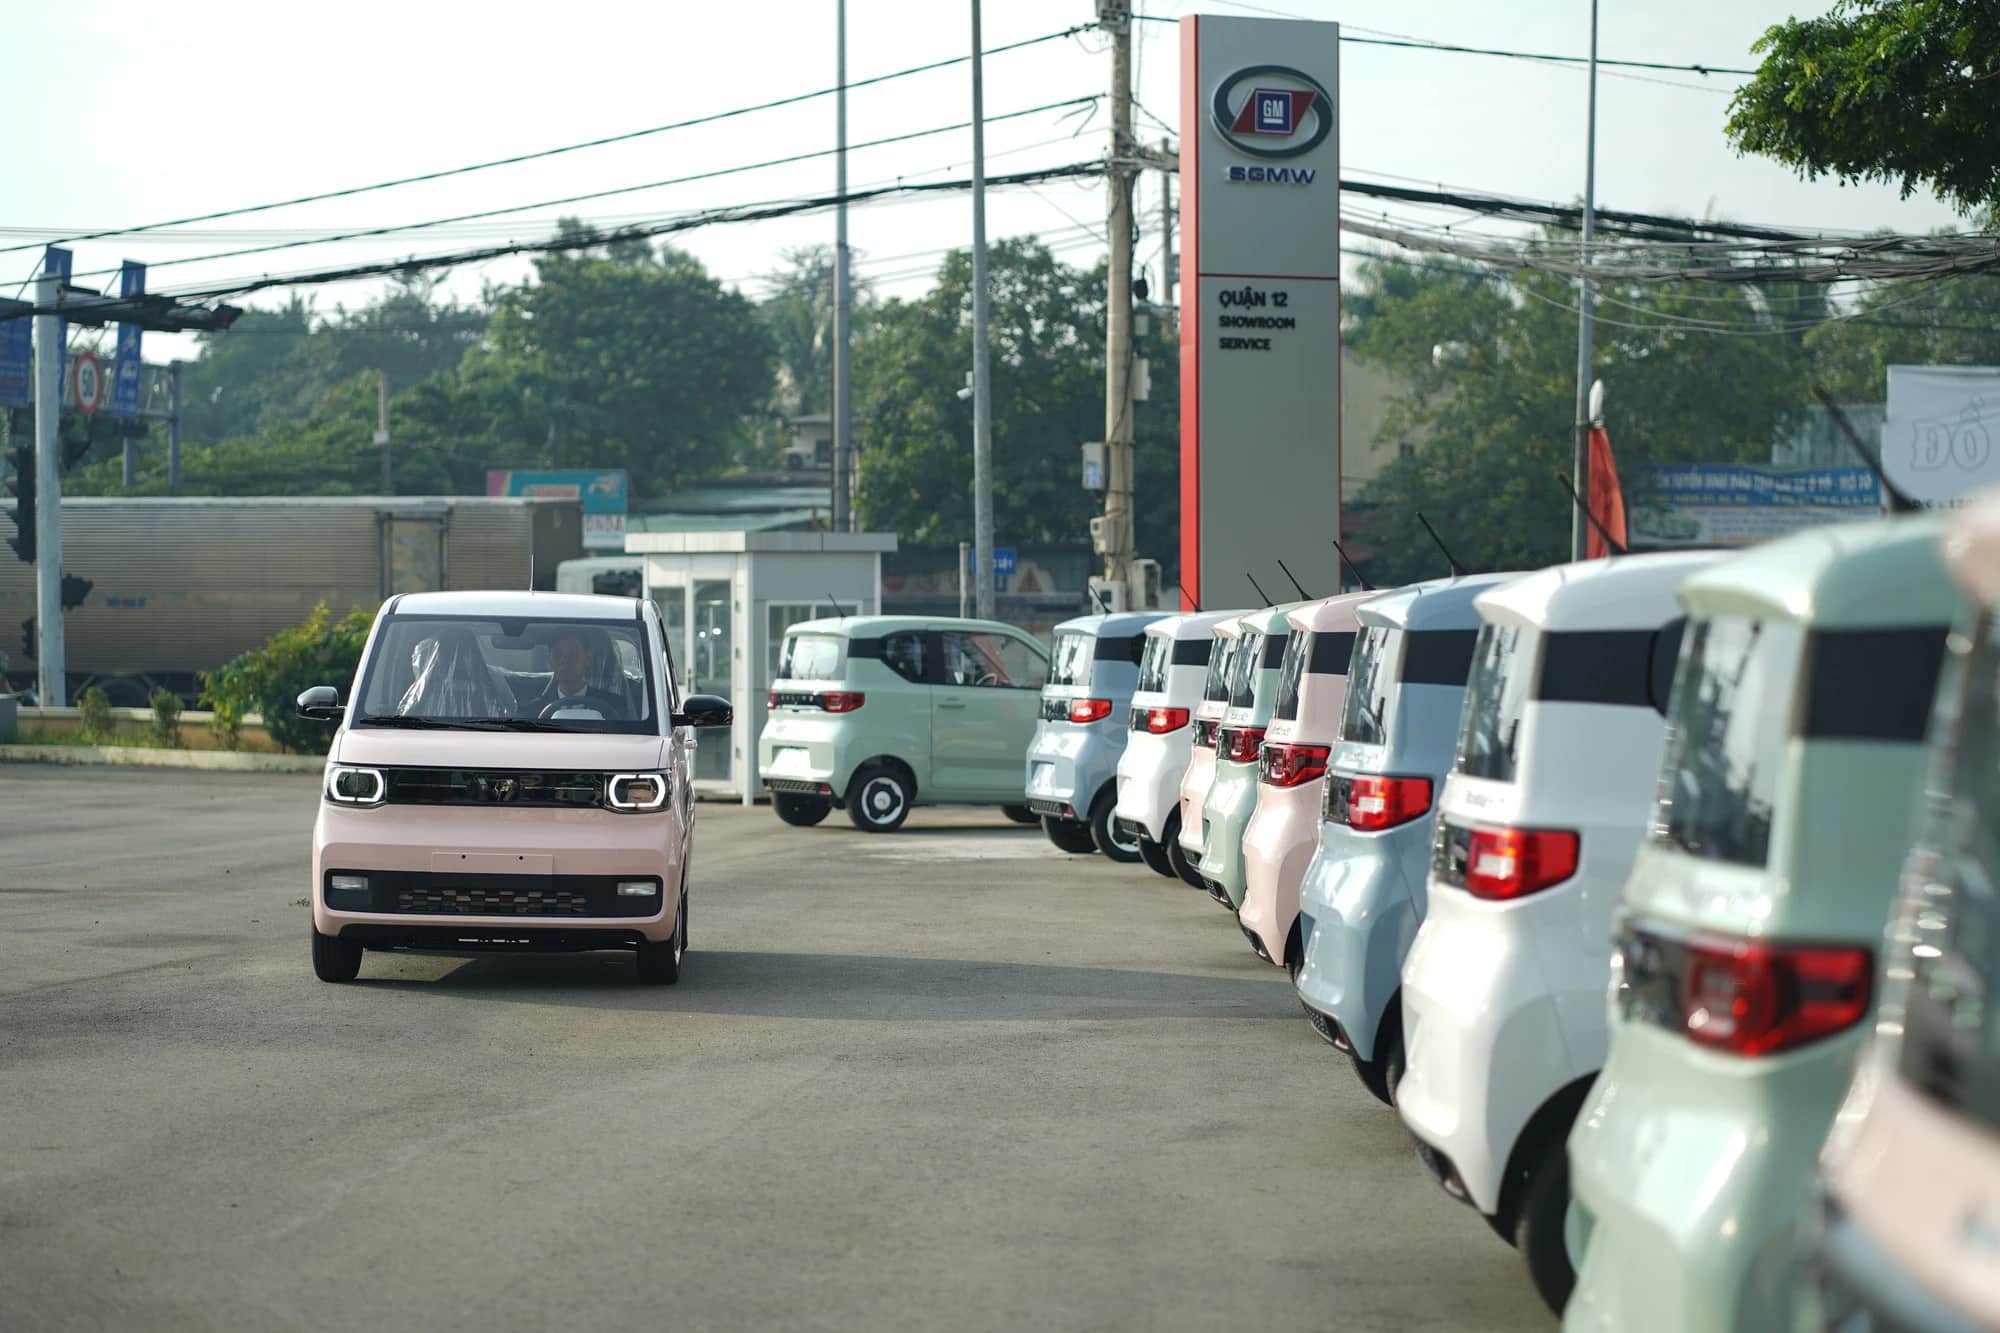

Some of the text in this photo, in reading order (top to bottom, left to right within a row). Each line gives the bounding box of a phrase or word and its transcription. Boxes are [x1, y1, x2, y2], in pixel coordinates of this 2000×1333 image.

[1263, 99, 1284, 118] GM
[1228, 166, 1316, 184] SGMW
[1219, 286, 1289, 310] QUẬN 12
[1219, 315, 1296, 329] SHOWROOM
[1219, 337, 1272, 351] SERVICE
